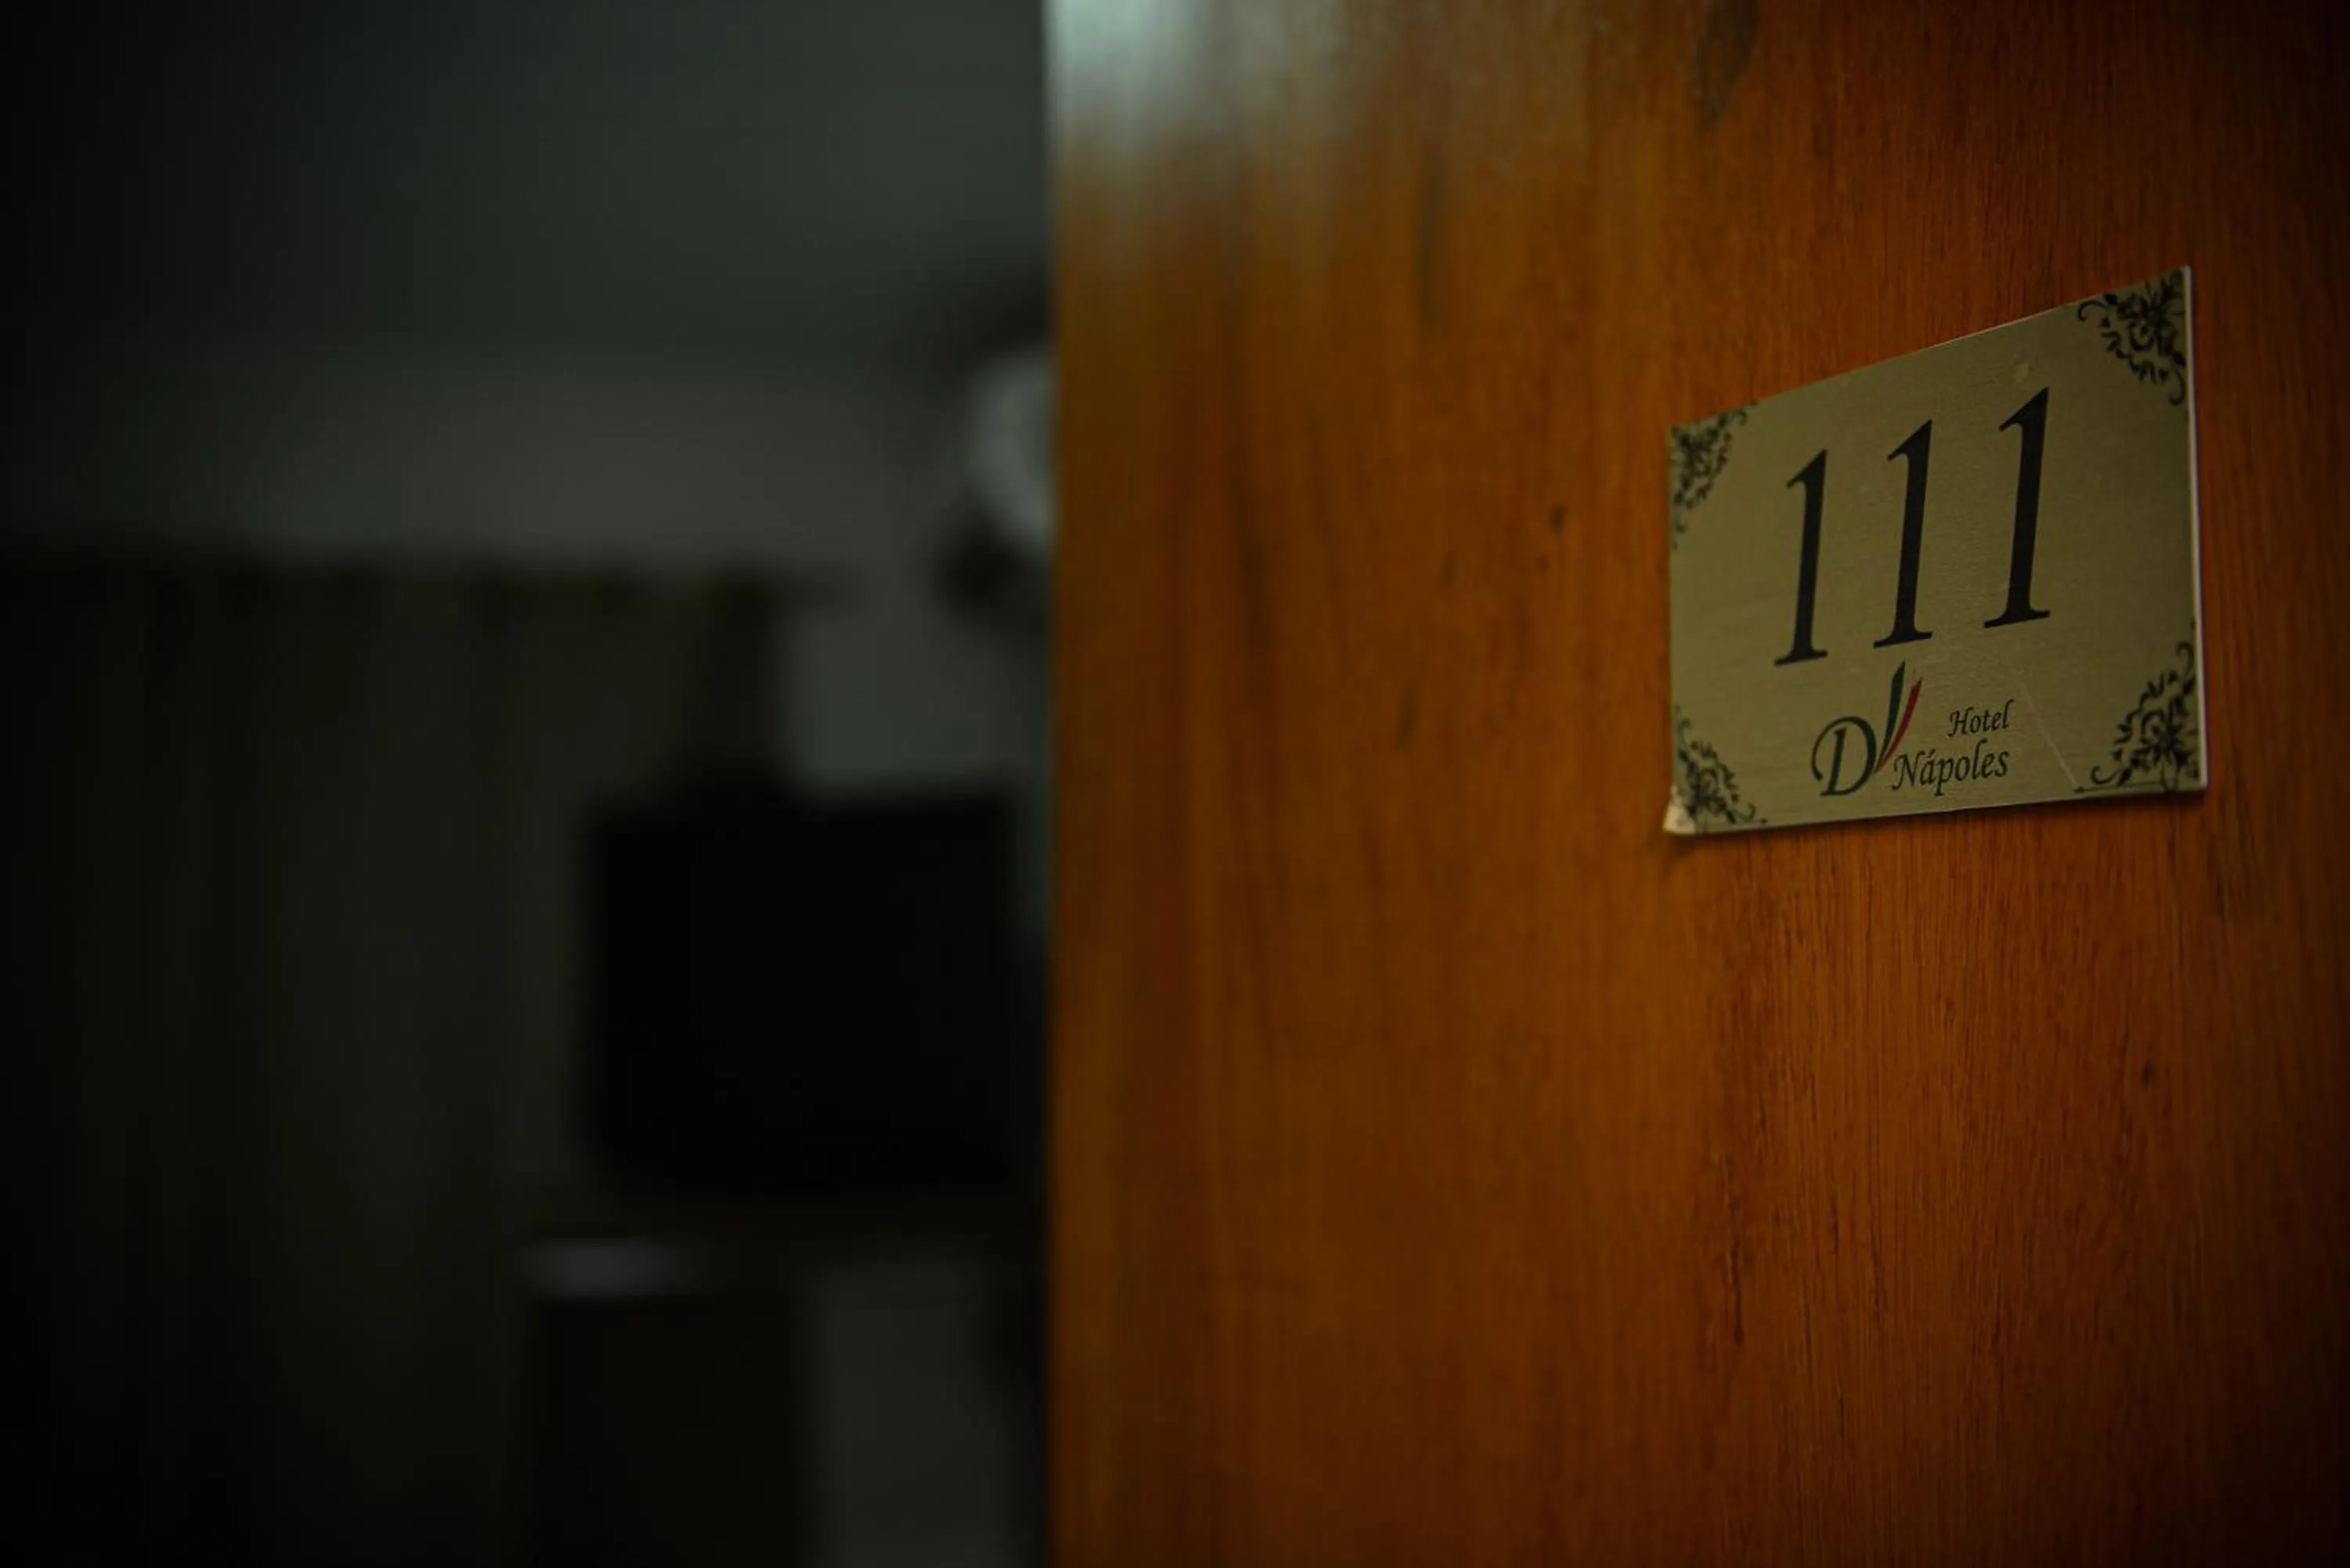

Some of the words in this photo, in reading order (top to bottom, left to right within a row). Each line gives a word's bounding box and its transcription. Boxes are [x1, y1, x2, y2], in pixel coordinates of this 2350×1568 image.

[1773, 386, 2051, 667] 111
[1947, 699, 2014, 737] Hotel
[1891, 739, 2009, 796] Nápoles
